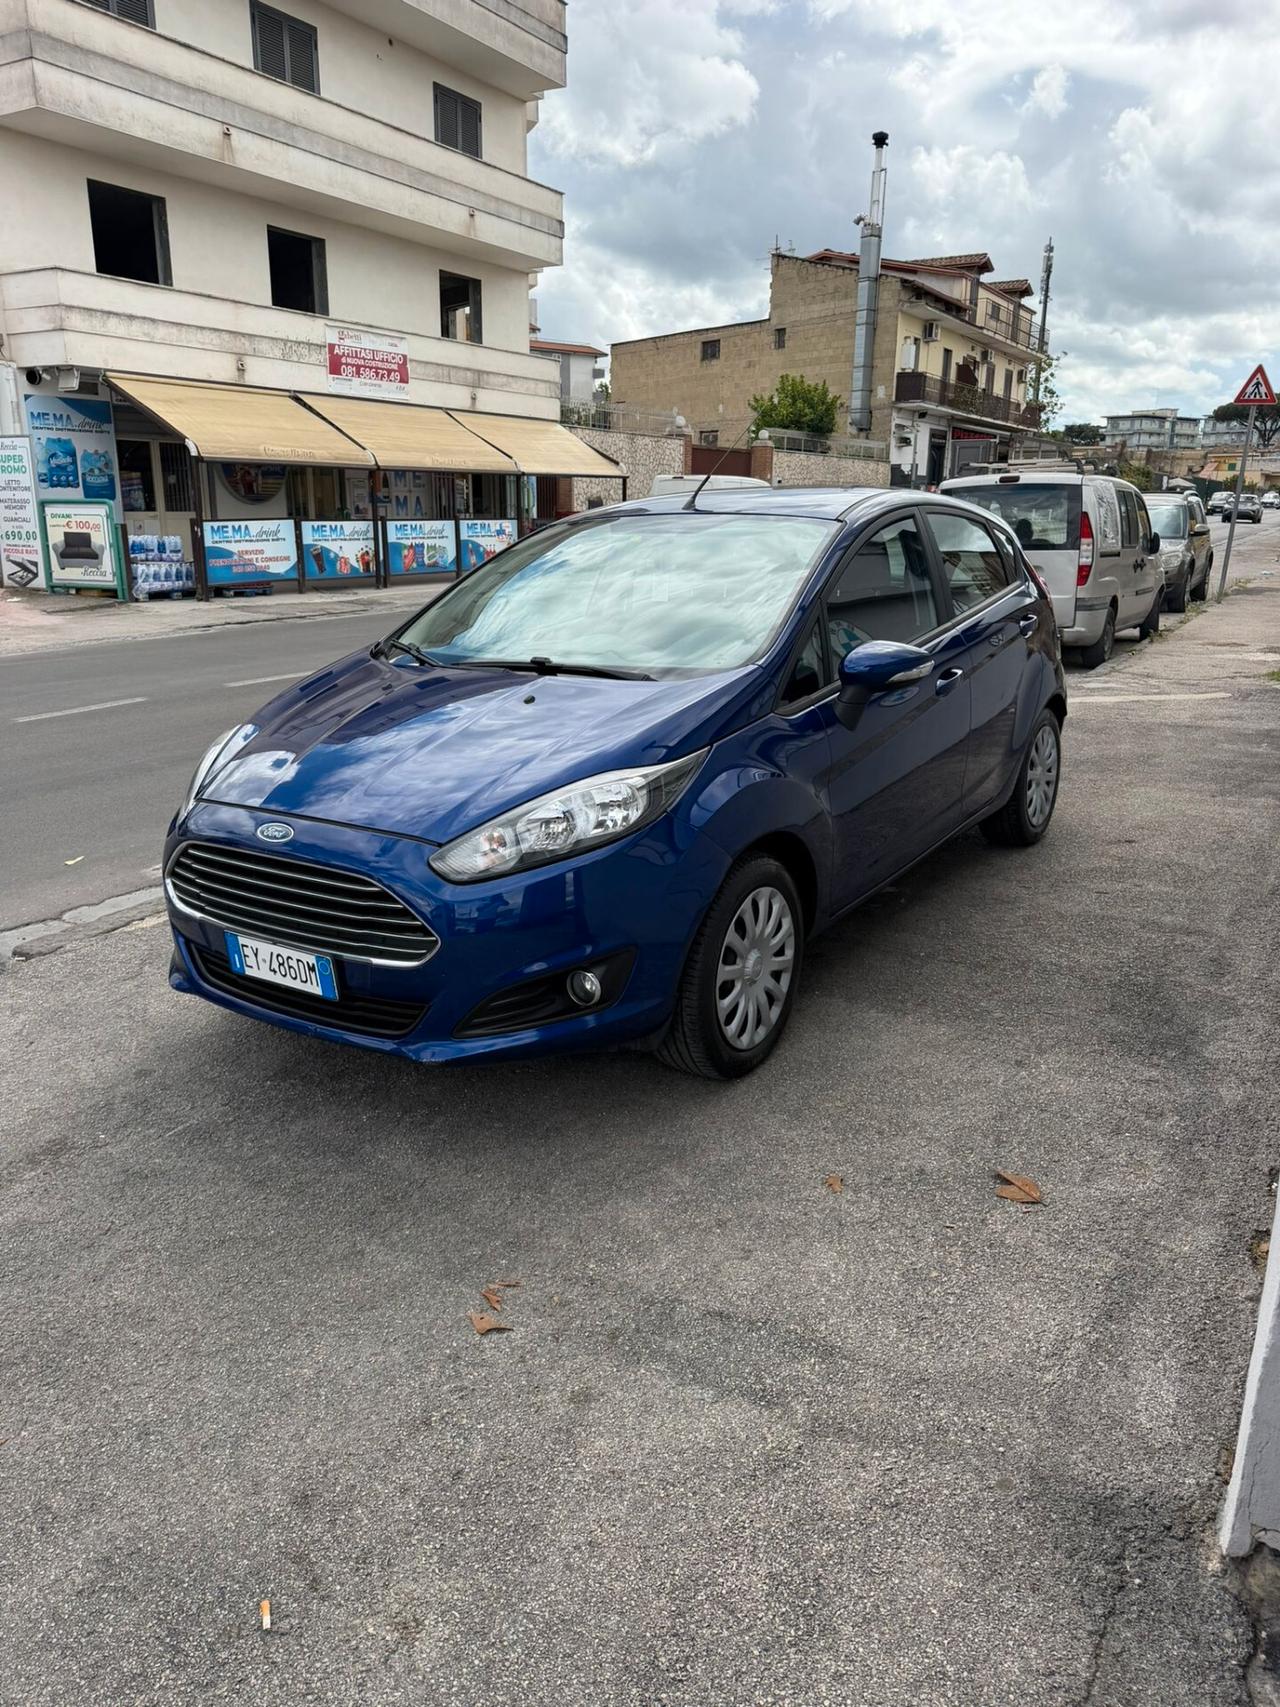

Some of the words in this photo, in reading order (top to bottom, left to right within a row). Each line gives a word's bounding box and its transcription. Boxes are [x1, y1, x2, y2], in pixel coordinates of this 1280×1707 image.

[334, 345, 373, 359] AFFITTASI
[374, 350, 403, 364] UFFICIO
[346, 357, 364, 365] NUOVA
[0, 454, 24, 464] UPER
[0, 464, 27, 474] ROMO
[75, 521, 101, 530] 100,00
[255, 524, 281, 537] drink
[349, 525, 370, 537] drink
[427, 524, 446, 535] drink
[5, 530, 37, 541] 690,00
